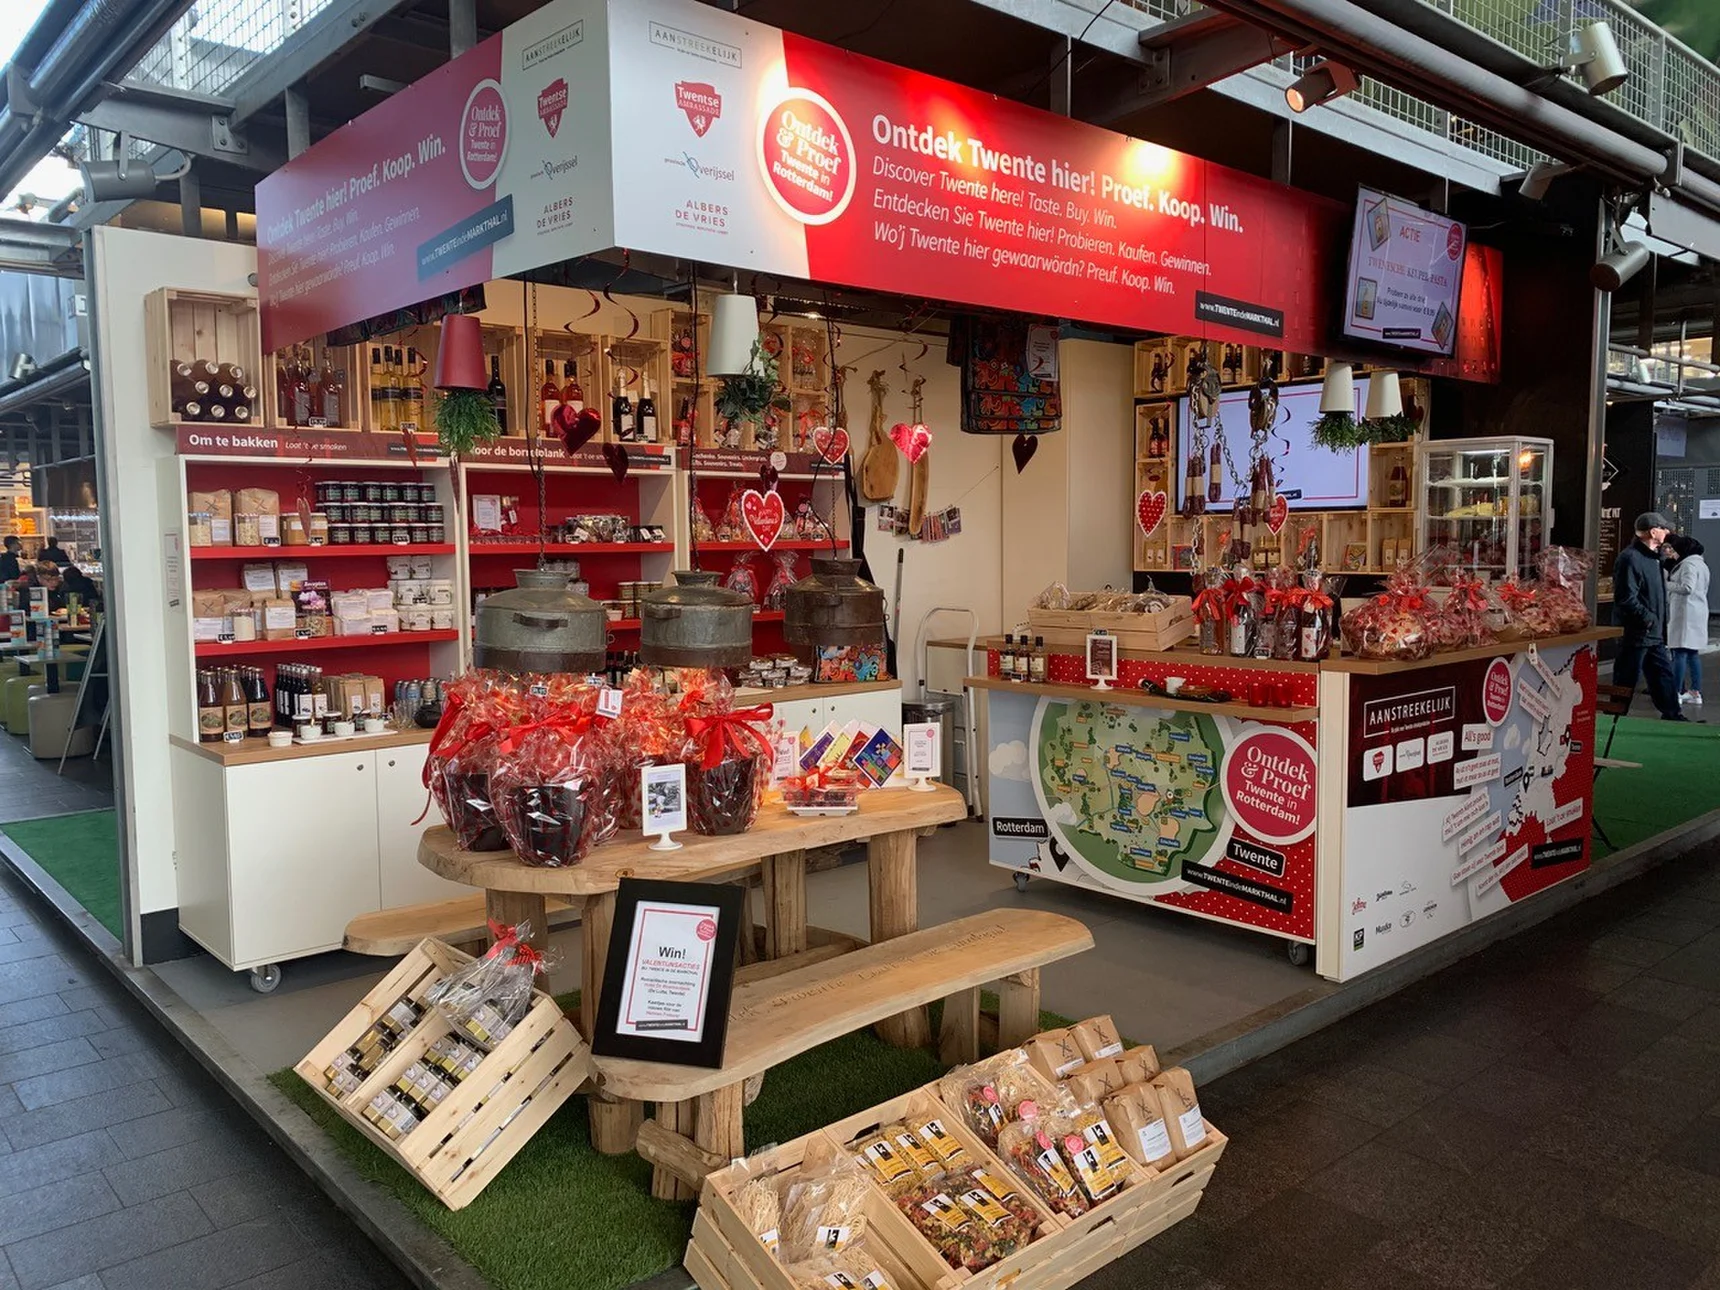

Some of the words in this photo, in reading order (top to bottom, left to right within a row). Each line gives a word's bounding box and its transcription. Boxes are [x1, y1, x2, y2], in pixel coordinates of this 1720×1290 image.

[654, 29, 737, 62] AANSTREEKELIJK
[539, 88, 567, 109] Twentse
[677, 86, 720, 108] Twentse
[471, 105, 501, 122] Ontdek
[469, 123, 477, 137] &
[479, 121, 501, 139] Proef
[781, 110, 839, 155] Ontdek
[467, 151, 497, 162] Rotterdam!
[471, 139, 490, 150] Twente
[776, 128, 793, 148] &
[797, 136, 841, 176] Proef
[781, 150, 819, 180] Twente
[821, 172, 830, 185] in
[872, 114, 963, 164] Ontdek
[967, 138, 1046, 184] Twente
[1051, 158, 1096, 196] hier!
[1101, 176, 1154, 211] Proef.
[1157, 189, 1206, 225] Koop.
[1208, 203, 1244, 234] Win.
[267, 211, 294, 244] Ontdek
[295, 199, 325, 231] Twente
[326, 181, 348, 212] hier!
[349, 163, 380, 199] Proef.
[383, 151, 415, 183] Koop.
[418, 133, 446, 165] Win.
[773, 161, 833, 203] Rotterdam!
[873, 155, 935, 189] Discover
[939, 171, 988, 200] Twente
[990, 180, 1024, 208] here!
[1028, 192, 1063, 217] Taste.
[1066, 200, 1090, 226] Buy.
[1093, 207, 1118, 230] Win.
[537, 217, 545, 228] DE
[549, 210, 571, 225] VRIES
[544, 197, 573, 215] ALBERS
[675, 209, 689, 221] DE
[693, 212, 726, 228] VRIES
[686, 199, 729, 216] ALBERS
[873, 188, 950, 223] Entdecken
[953, 205, 975, 228] Sie
[978, 210, 1024, 239] Twente
[1026, 220, 1055, 245] hier!
[1057, 228, 1115, 257] Probieren.
[1118, 241, 1158, 266] Kaufen.
[1160, 250, 1212, 277] Gewinnen.
[1399, 225, 1422, 243] ACTIE
[874, 221, 906, 251] Wo'j
[909, 228, 960, 256] Twente
[963, 238, 988, 262] hier
[991, 246, 1085, 279] gewaarwördn?
[1087, 264, 1119, 285] Preuf.
[1121, 270, 1151, 294] Koop.
[1154, 275, 1176, 295] Win.
[189, 434, 212, 447] Om
[214, 435, 229, 448] te
[232, 434, 278, 449] bakken
[319, 442, 347, 451] smaken
[494, 446, 507, 457] de
[1369, 696, 1451, 726] AANSTREEKELIJK
[1464, 730, 1476, 743] All's
[1477, 731, 1492, 745] good
[1247, 745, 1309, 783] Ontdek
[1241, 761, 1259, 778] &
[1261, 768, 1312, 801] Proef
[1235, 791, 1301, 826] Rotterdam!
[1245, 779, 1285, 807] Twente
[1287, 797, 1297, 811] in
[996, 821, 1045, 835] Rotterdam
[1233, 843, 1278, 870] Twente
[1187, 867, 1288, 906] www.TWENTEindeMARKTHAL.nl
[659, 946, 686, 959] Win!
